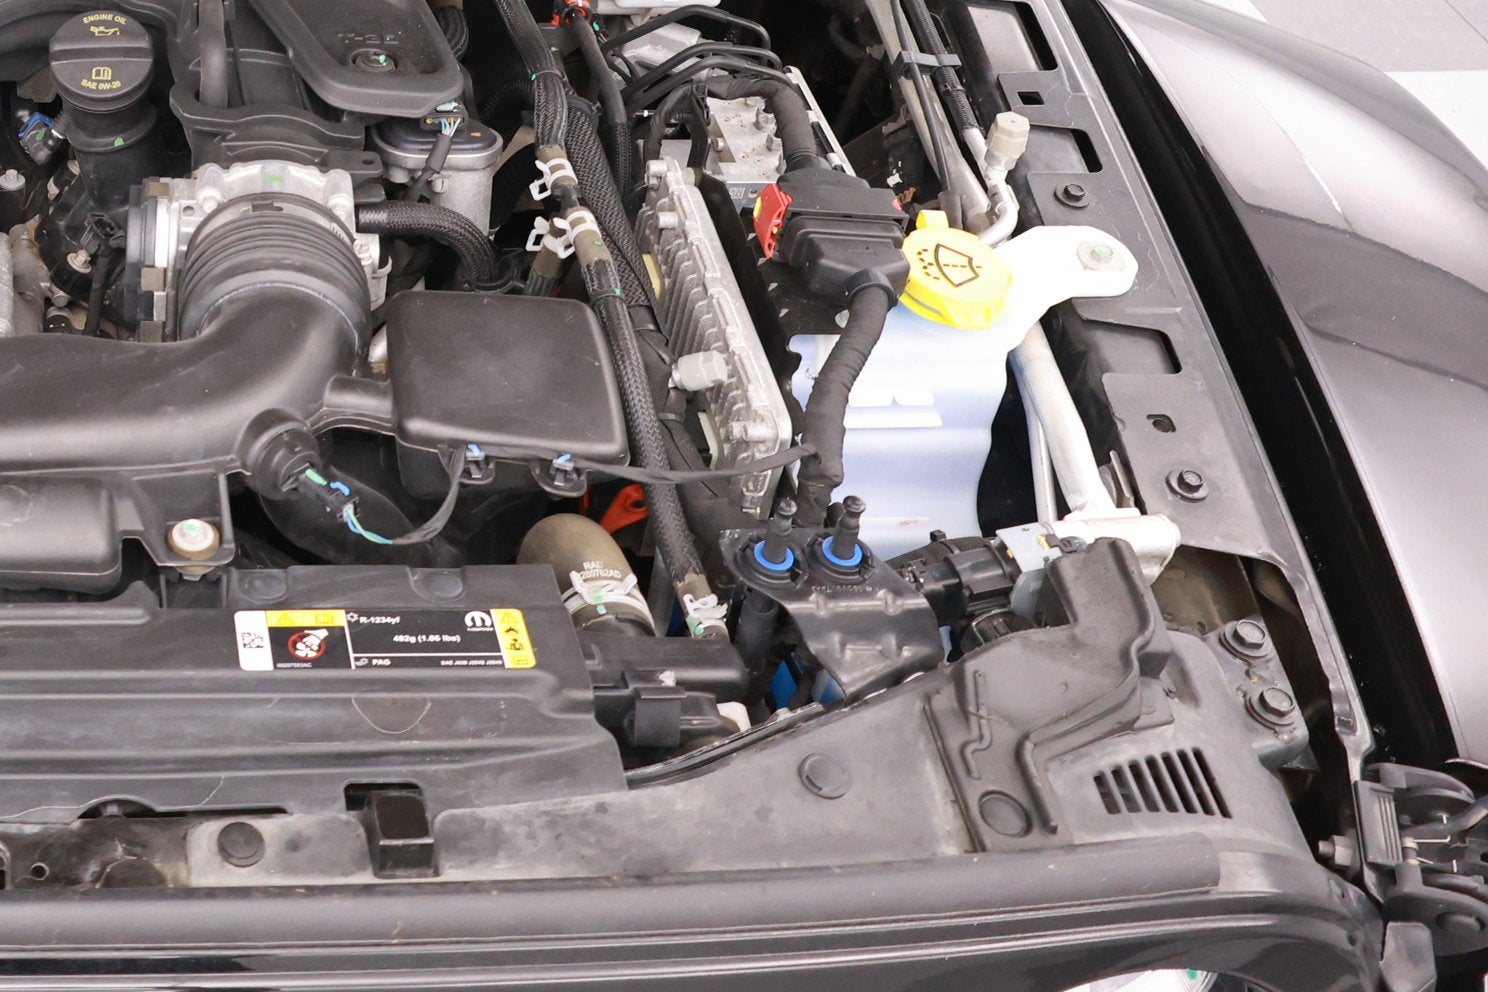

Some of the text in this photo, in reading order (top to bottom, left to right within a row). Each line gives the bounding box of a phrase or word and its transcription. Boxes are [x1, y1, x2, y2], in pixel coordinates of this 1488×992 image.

[82, 13, 127, 25] ENGINE OIL
[80, 79, 97, 89] SAE
